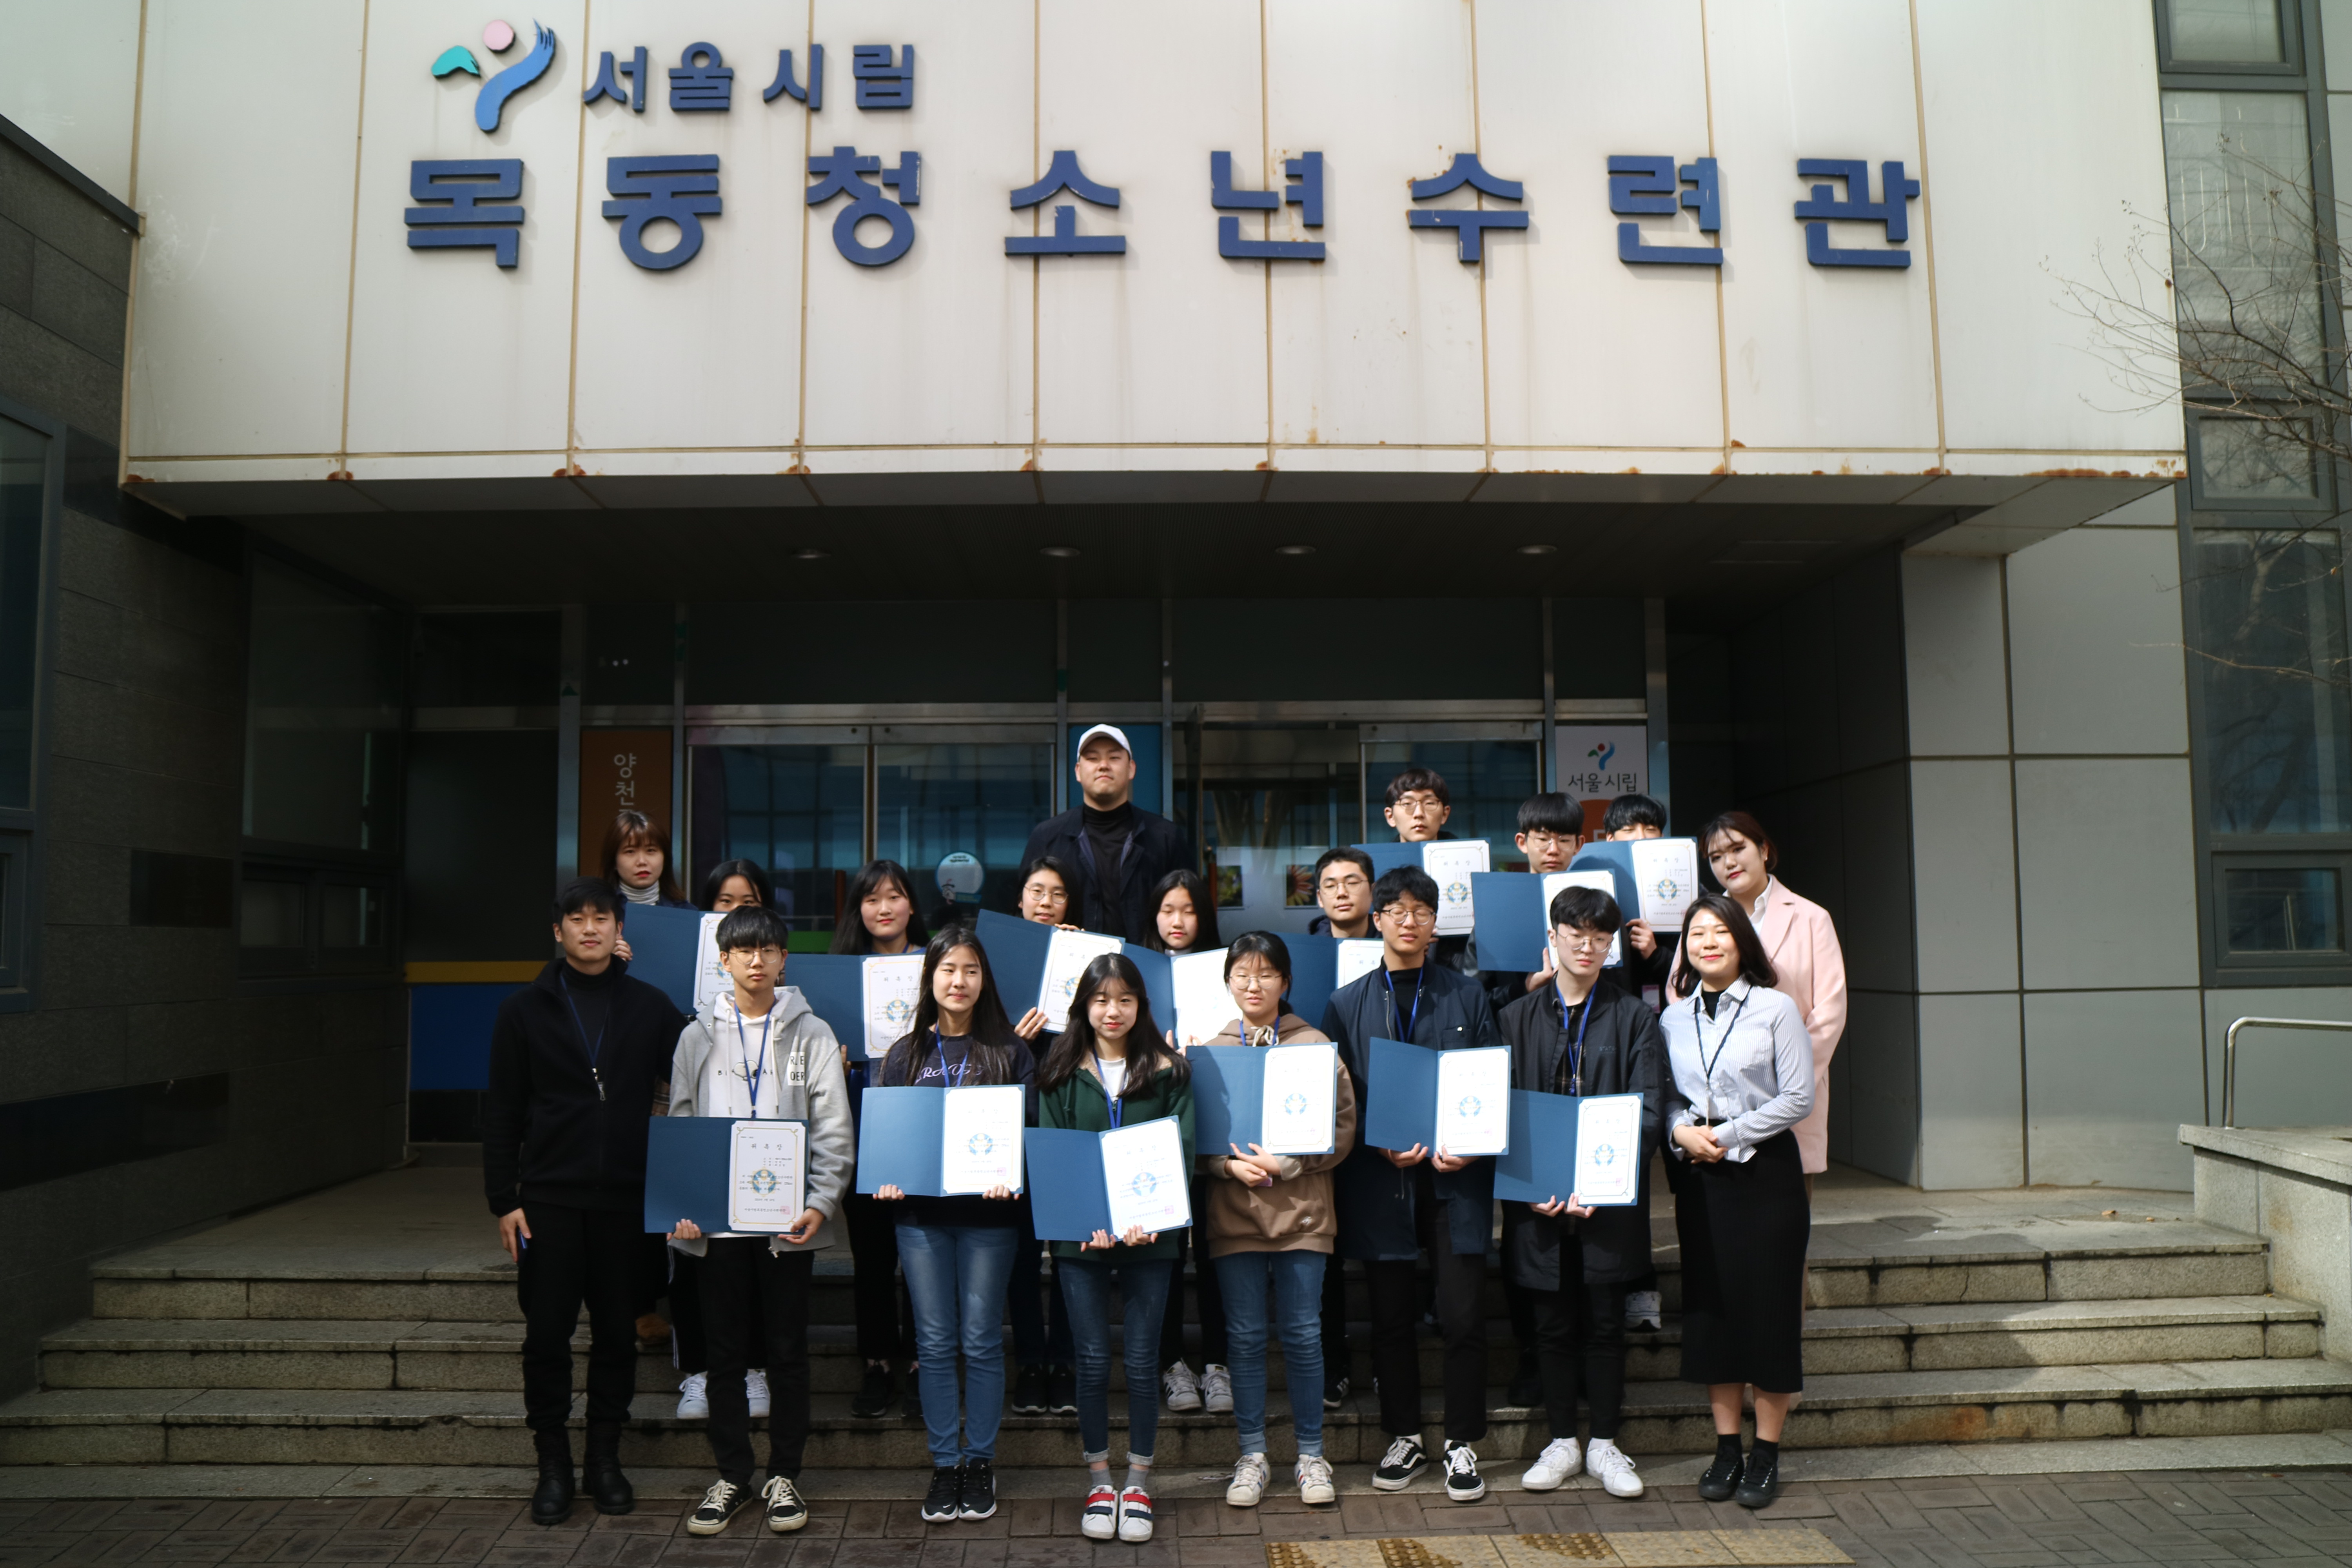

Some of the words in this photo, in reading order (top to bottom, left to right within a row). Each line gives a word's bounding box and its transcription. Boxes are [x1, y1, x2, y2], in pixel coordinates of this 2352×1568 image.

[584, 42, 914, 112] 서울시립
[405, 146, 1920, 270] 목동청소년수련관
[613, 753, 637, 811] 양천
[1568, 773, 1636, 793] 서울시립
